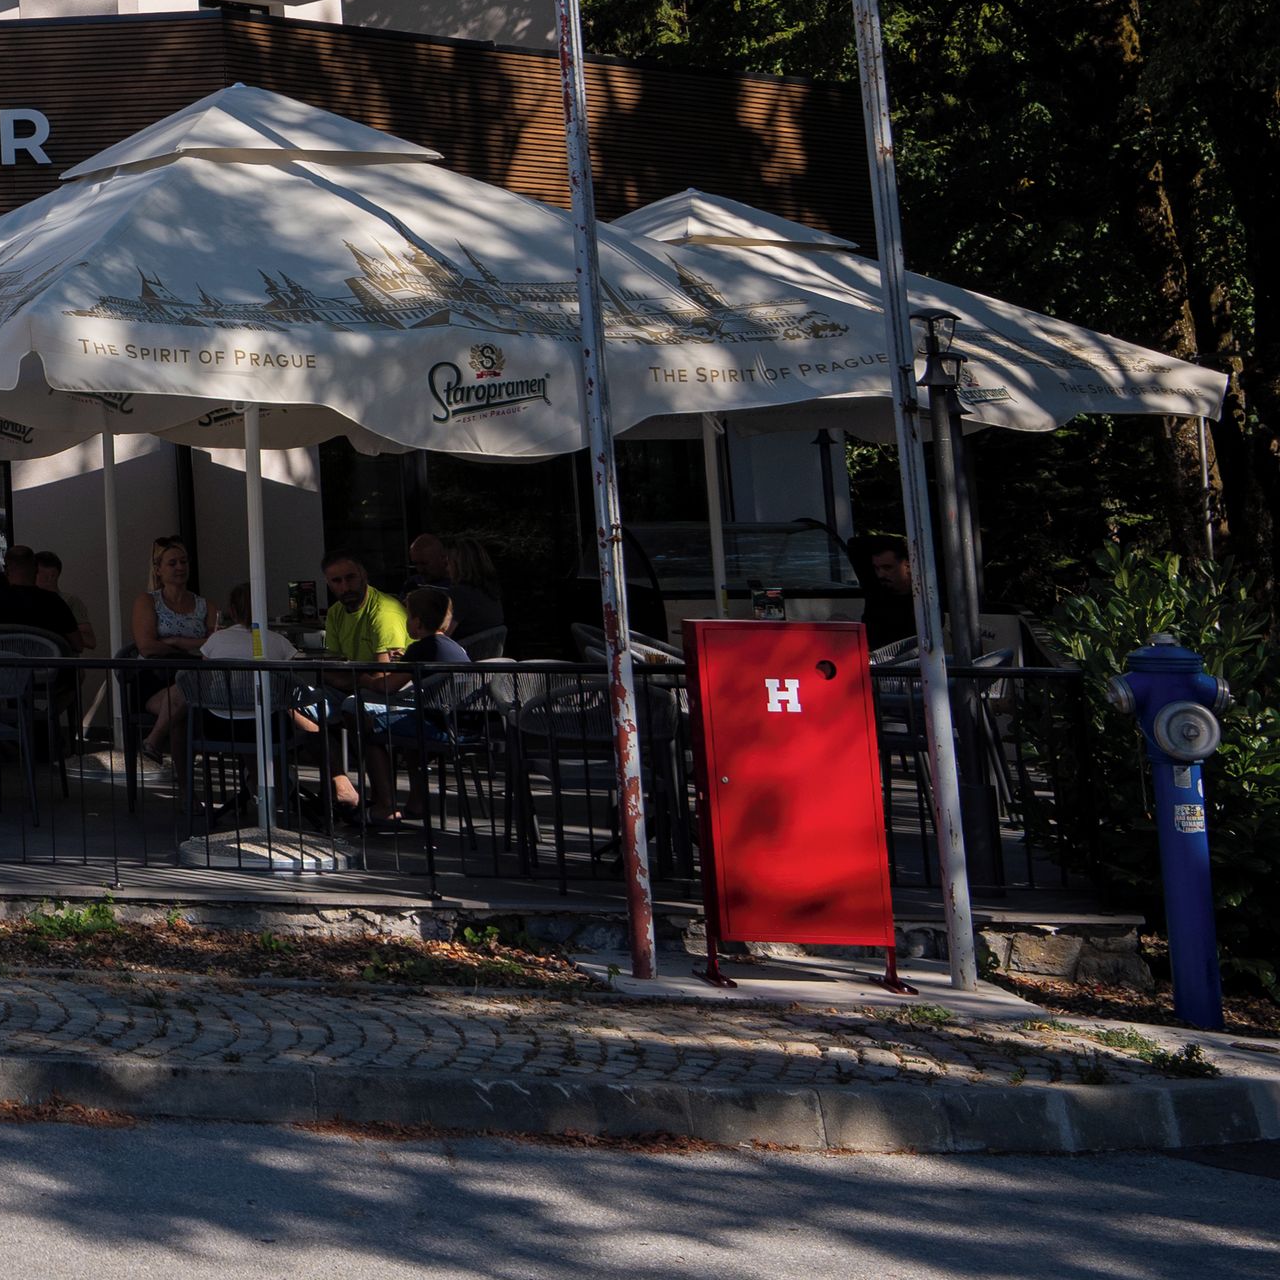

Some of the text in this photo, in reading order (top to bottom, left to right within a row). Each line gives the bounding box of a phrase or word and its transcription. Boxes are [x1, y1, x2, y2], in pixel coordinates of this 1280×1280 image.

[78, 338, 317, 369] THE SPIRIT OF PRAGUE
[649, 352, 890, 383] THE SPIRIT OF PRAGUE
[428, 361, 552, 423] Staropramen
[1060, 382, 1204, 398] THE SPIRIT OF PRAGUE
[490, 406, 521, 417] PRAGUE
[765, 679, 801, 712] H
